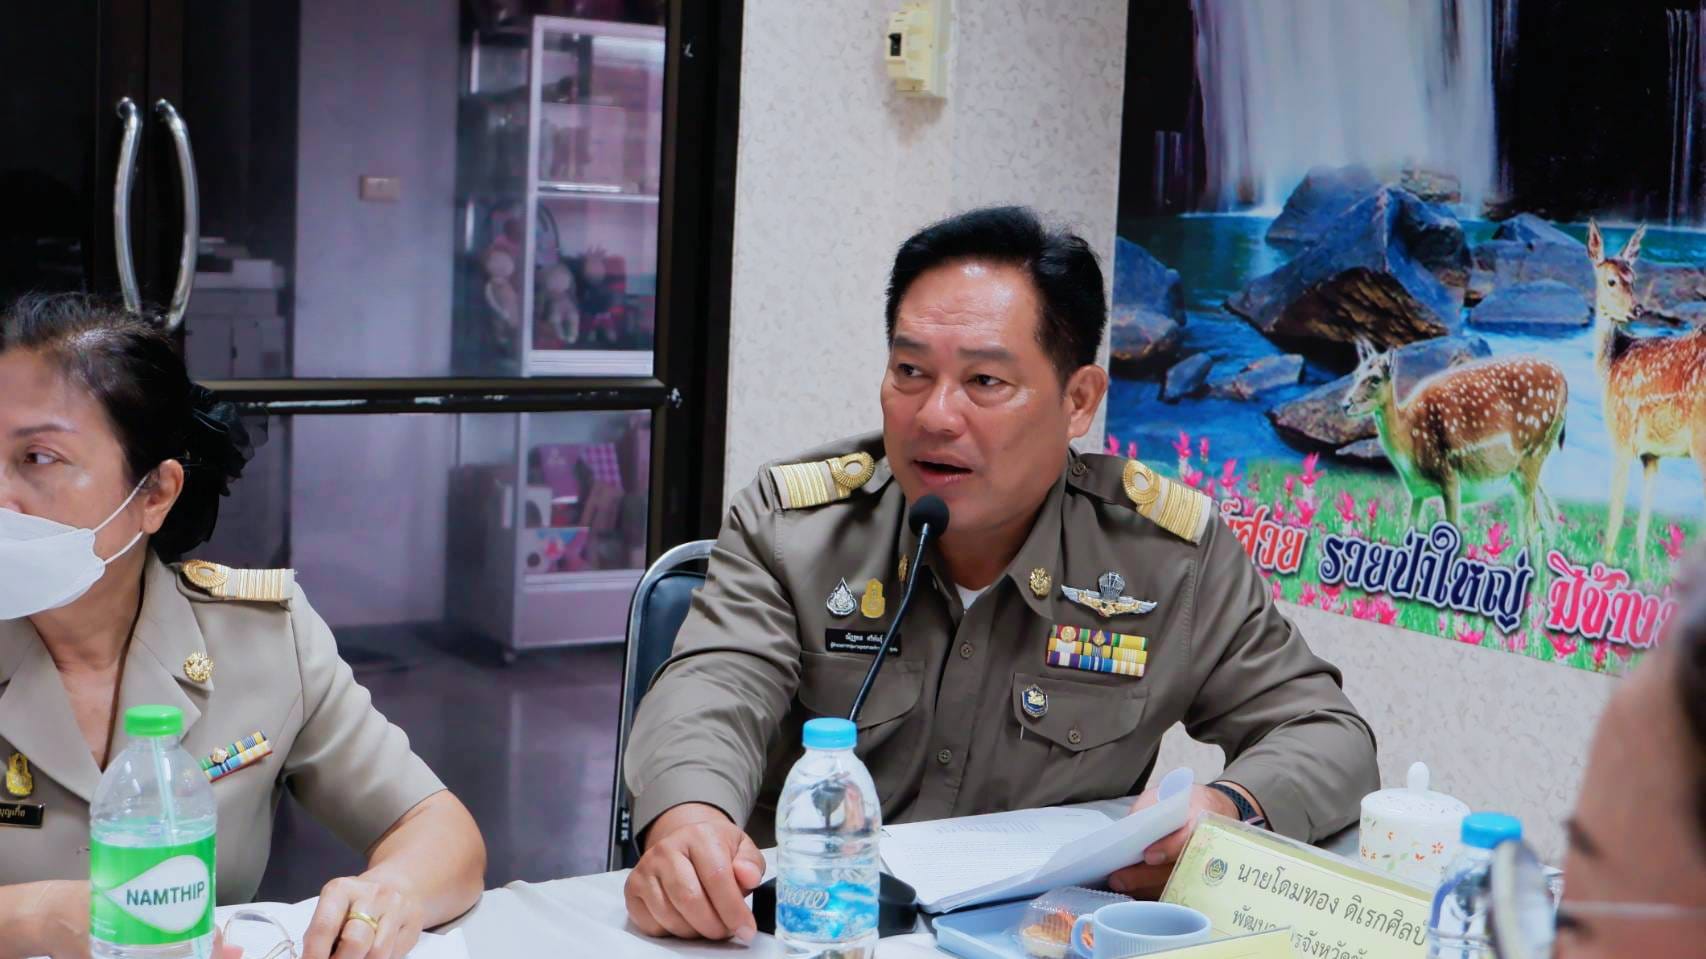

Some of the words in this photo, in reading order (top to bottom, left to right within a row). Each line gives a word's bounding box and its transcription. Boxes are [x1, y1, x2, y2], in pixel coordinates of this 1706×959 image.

[1319, 522, 1534, 632] รวยป่าใหญ่
[127, 881, 205, 905] NAMTHIP
[1238, 864, 1339, 915] นายโดมทอง
